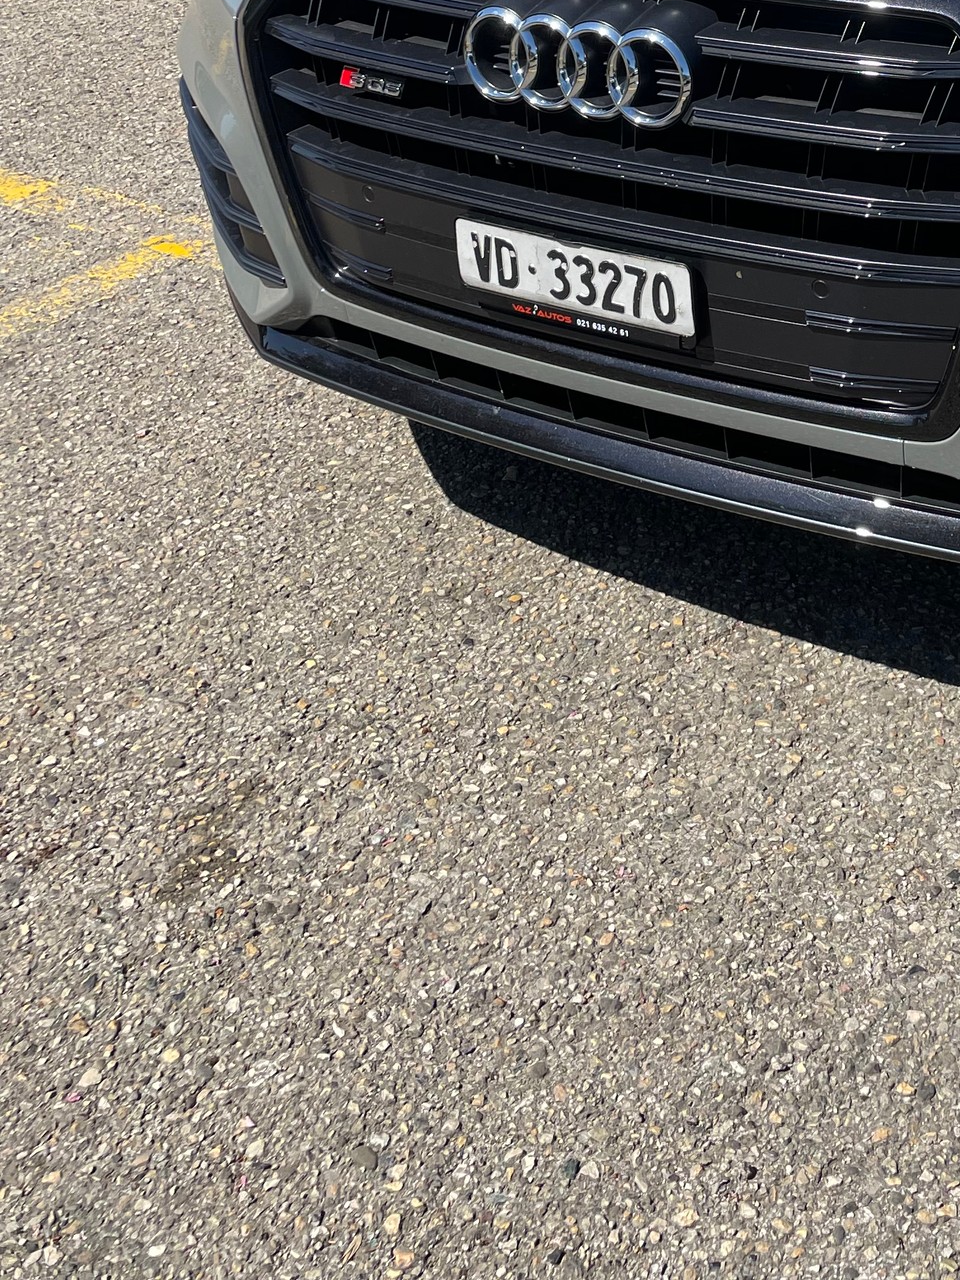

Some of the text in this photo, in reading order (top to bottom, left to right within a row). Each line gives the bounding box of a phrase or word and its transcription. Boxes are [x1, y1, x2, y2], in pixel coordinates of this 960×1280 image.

[471, 231, 677, 324] VD 33270
[537, 310, 573, 324] AUTOS
[576, 319, 590, 328] 021
[608, 325, 618, 335] 42
